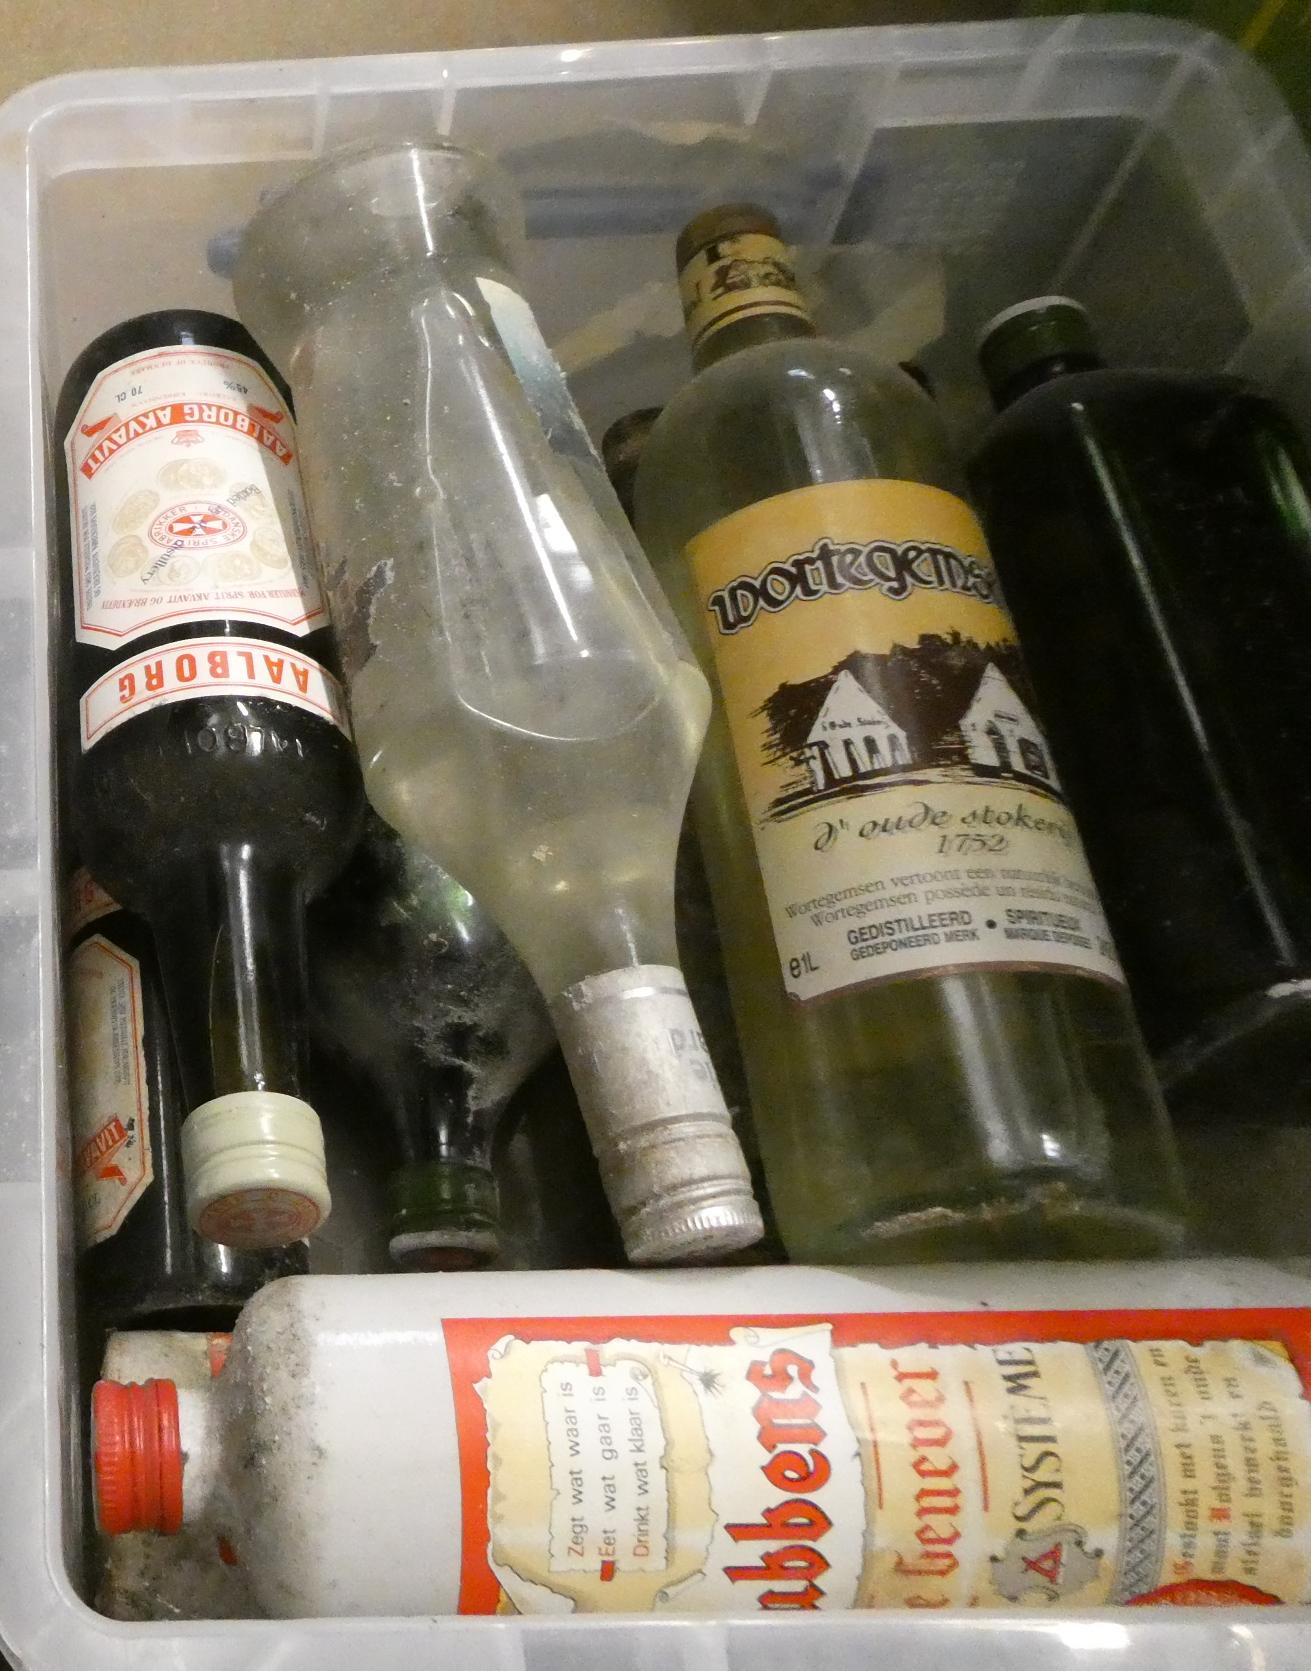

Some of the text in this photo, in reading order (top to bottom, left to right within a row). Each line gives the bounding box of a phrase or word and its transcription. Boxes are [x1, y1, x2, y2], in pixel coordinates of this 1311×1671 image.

[116, 391, 128, 405] CL
[131, 384, 144, 398] 70
[89, 404, 288, 474] AALBORG AKVAVIT
[149, 594, 165, 605] OG
[167, 592, 209, 604] AKVAVIT
[214, 591, 248, 601] SPRIT
[118, 650, 310, 704] AALBORG
[858, 802, 952, 840] oude
[936, 833, 1009, 855] 1752
[784, 880, 886, 919] Wortegemsen
[809, 891, 919, 928] Wortegemsen
[847, 909, 973, 946] GEDISTILLEERD
[849, 931, 942, 962] GEDEPONEERD
[943, 926, 981, 944] MERK
[561, 1380, 586, 1559] Zegt wat waar is
[591, 1384, 620, 1560] Eet wat gaar is
[624, 1385, 653, 1560] Drinkt wat klaar is
[723, 1347, 834, 1612] ubbens
